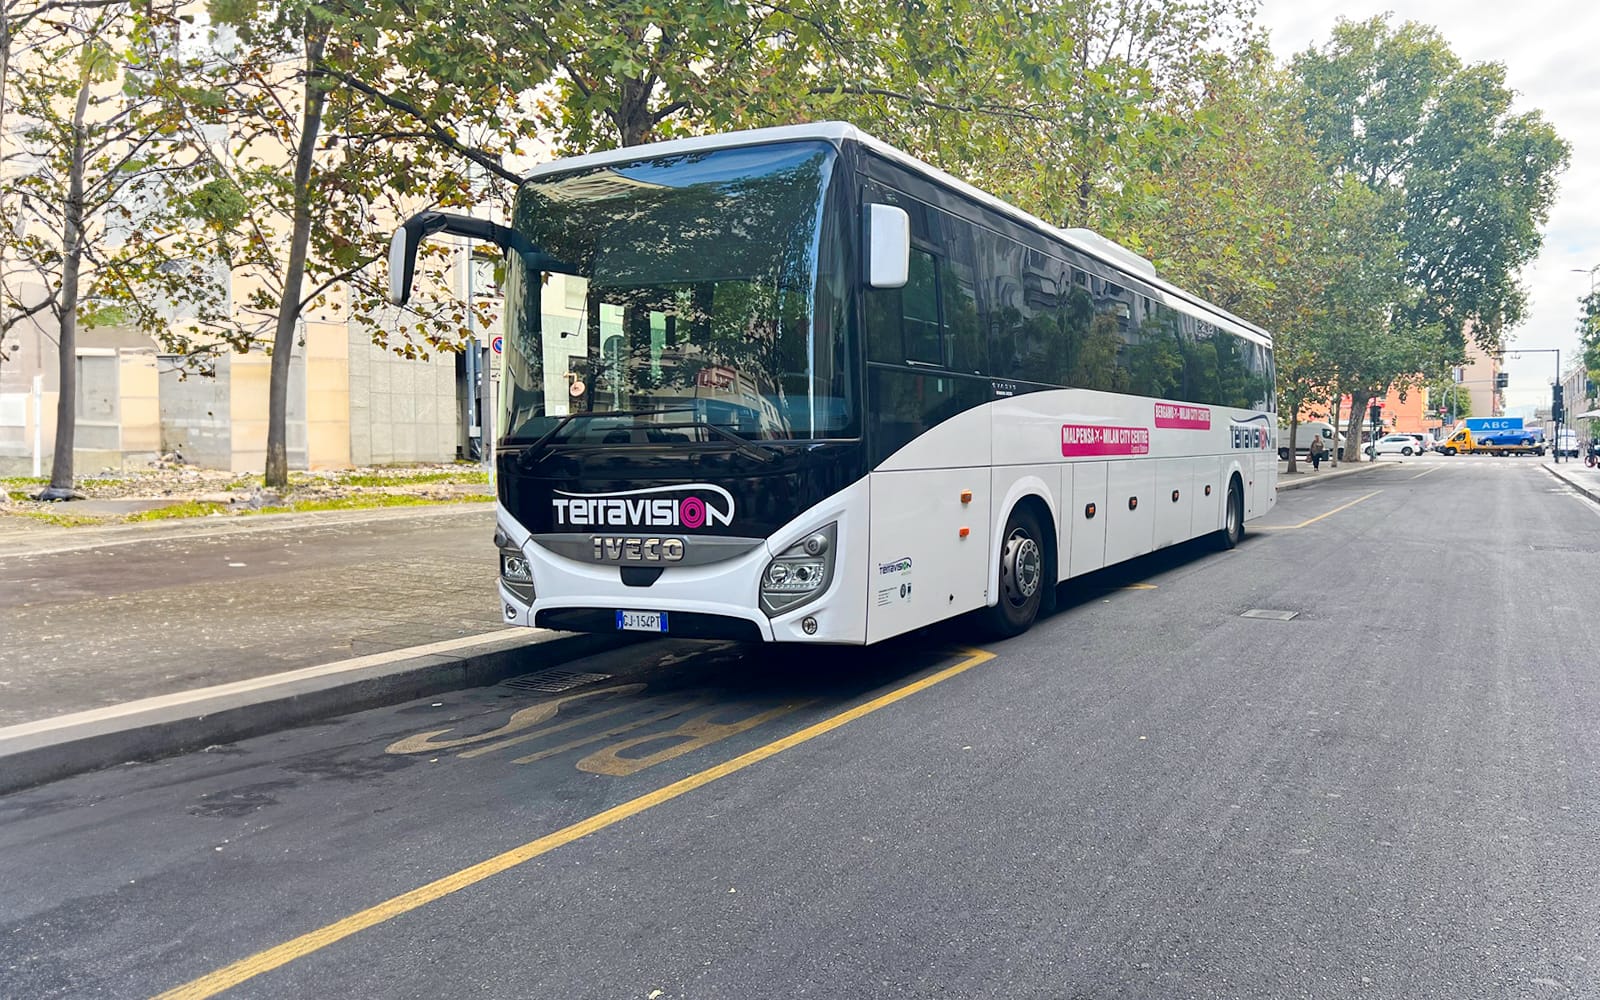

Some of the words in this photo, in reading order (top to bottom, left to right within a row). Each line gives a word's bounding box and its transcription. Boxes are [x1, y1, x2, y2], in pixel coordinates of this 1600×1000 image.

[1155, 405, 1174, 419] BERGAMO
[1180, 407, 1191, 420] MILAN
[1482, 421, 1509, 429] ABC
[1063, 427, 1095, 444] MALPENSA
[1103, 428, 1119, 444] MILAN
[1120, 429, 1131, 444] CITY
[1131, 430, 1148, 444] CENTRE
[593, 537, 685, 561] IVECO
